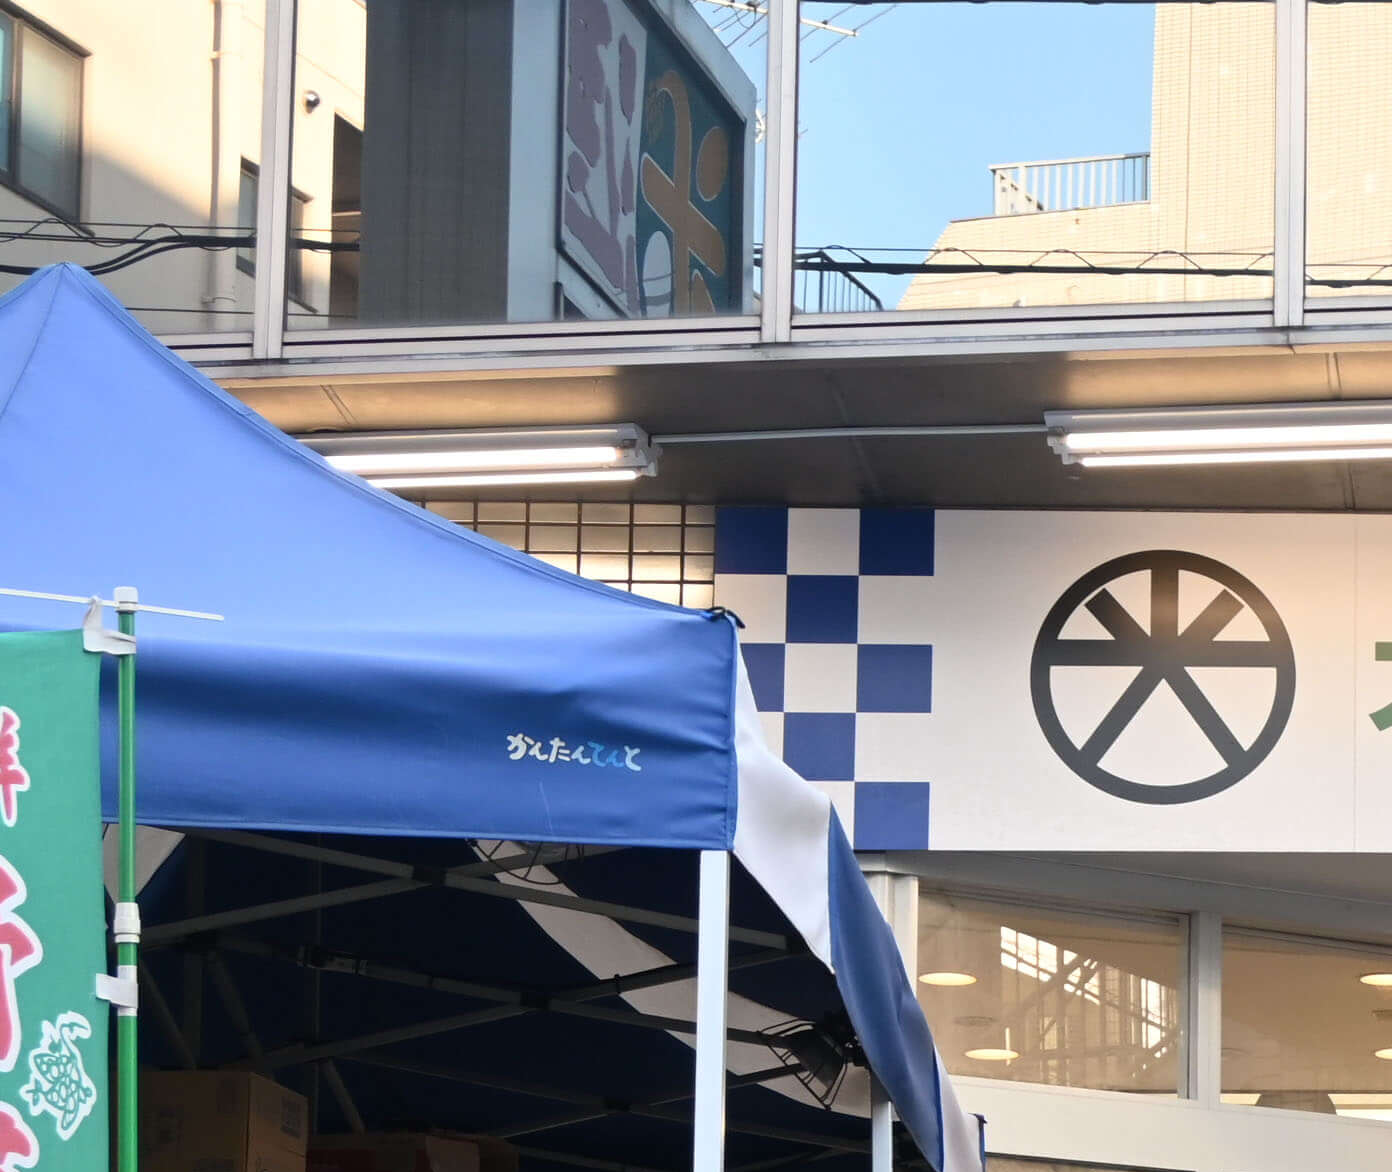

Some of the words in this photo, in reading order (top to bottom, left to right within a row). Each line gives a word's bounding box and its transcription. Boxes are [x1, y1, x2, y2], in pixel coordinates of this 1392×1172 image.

[506, 732, 642, 772] かんたんてんと
